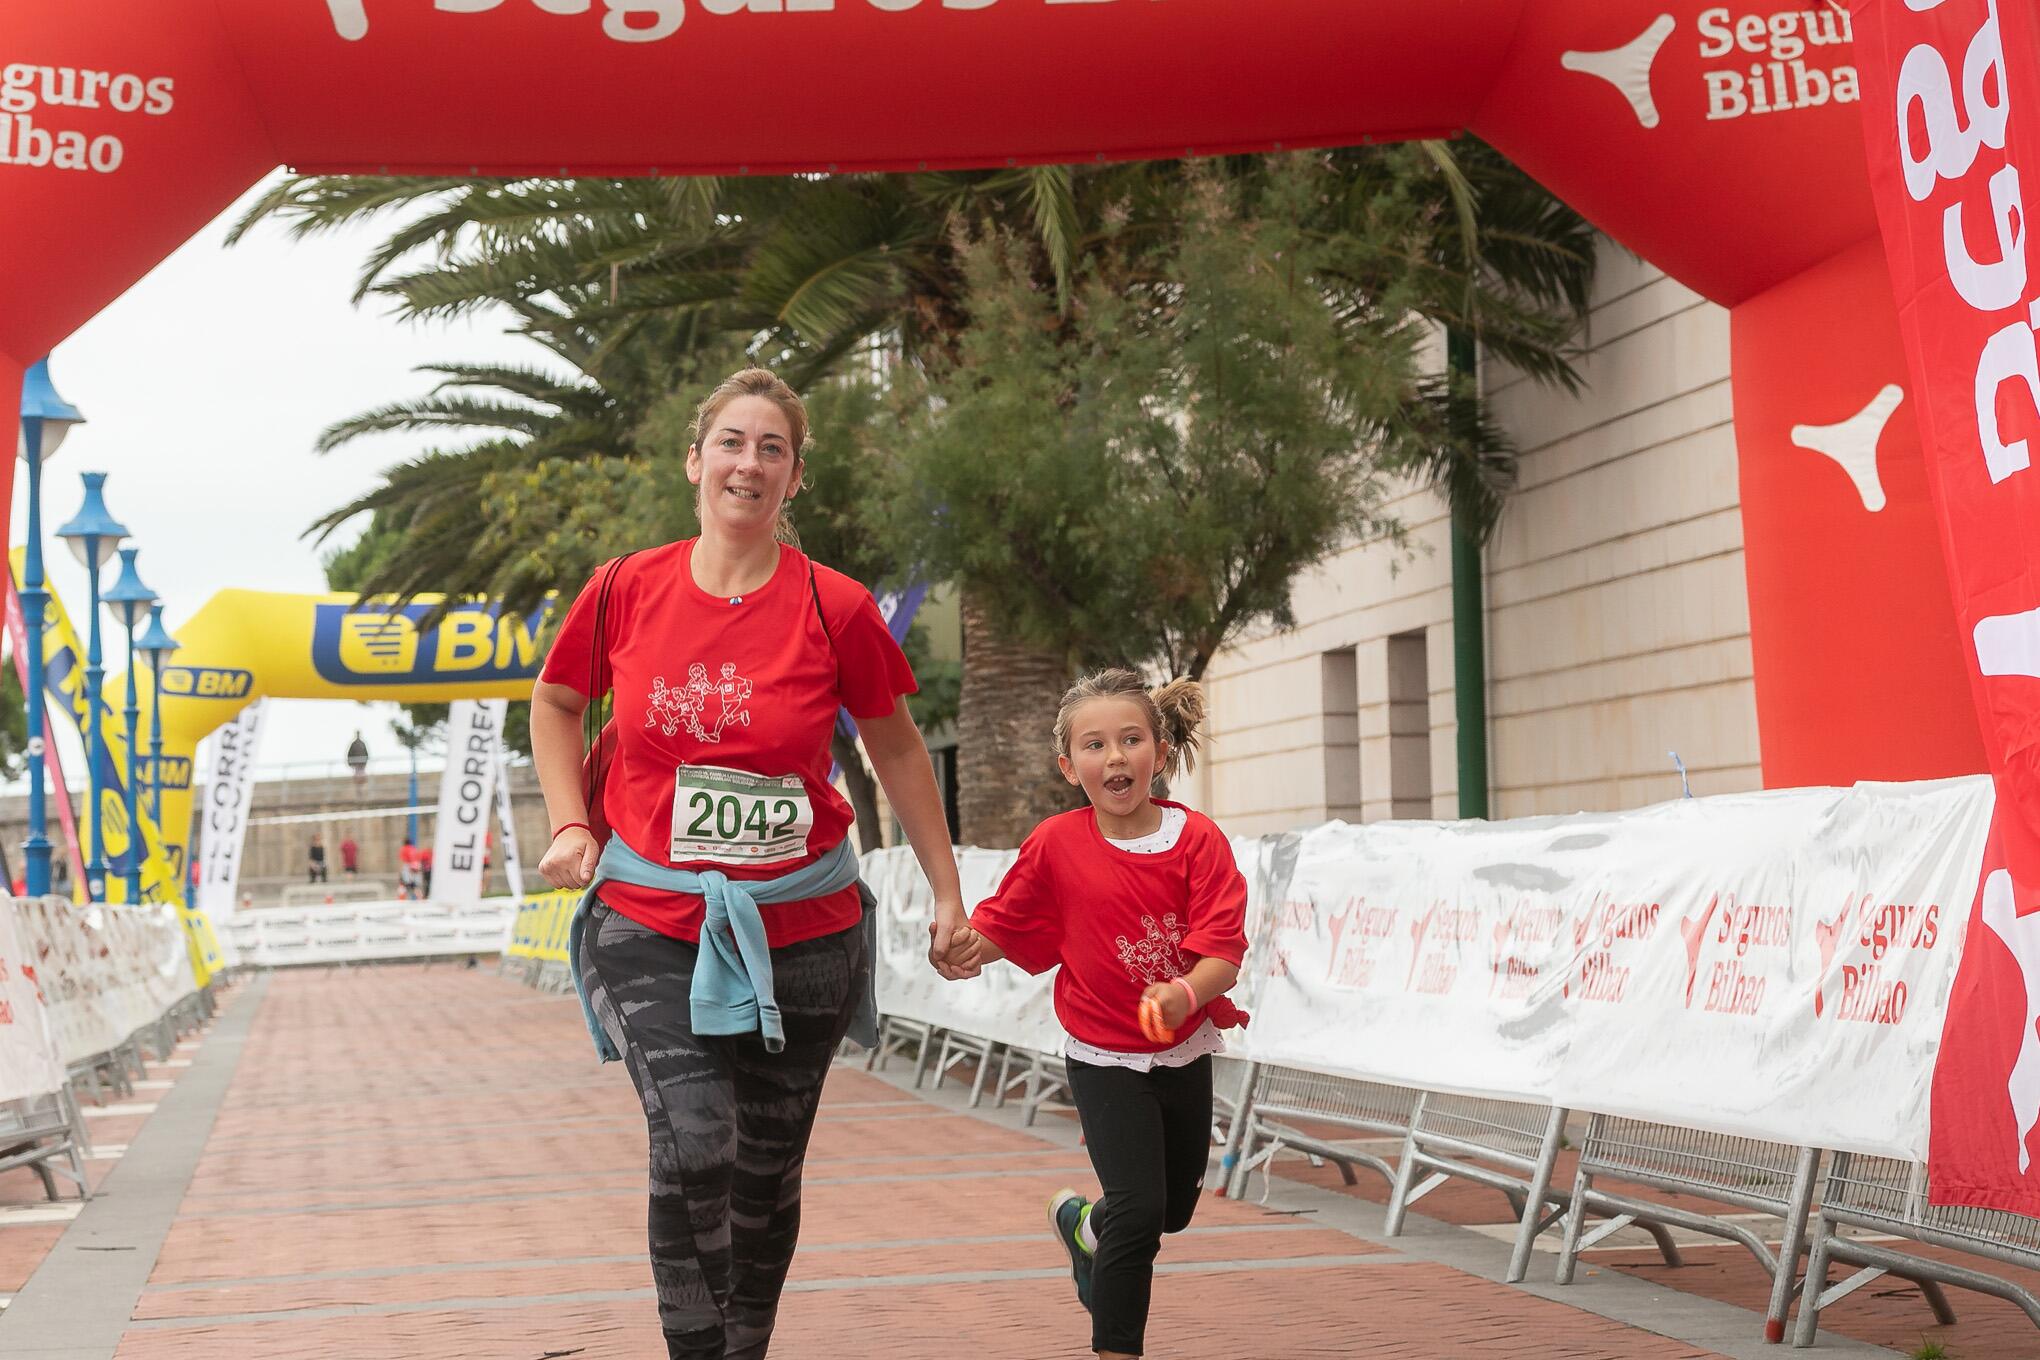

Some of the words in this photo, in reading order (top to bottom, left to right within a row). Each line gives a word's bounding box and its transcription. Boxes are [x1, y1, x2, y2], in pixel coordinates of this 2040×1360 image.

[0, 63, 174, 115] guros
[196, 670, 248, 697] BM
[687, 791, 798, 840] 2042
[452, 834, 476, 872] EL
[1718, 892, 1793, 957] Seguros
[1704, 959, 1766, 1016] Bilbao
[1837, 963, 1908, 1025] Bilbao
